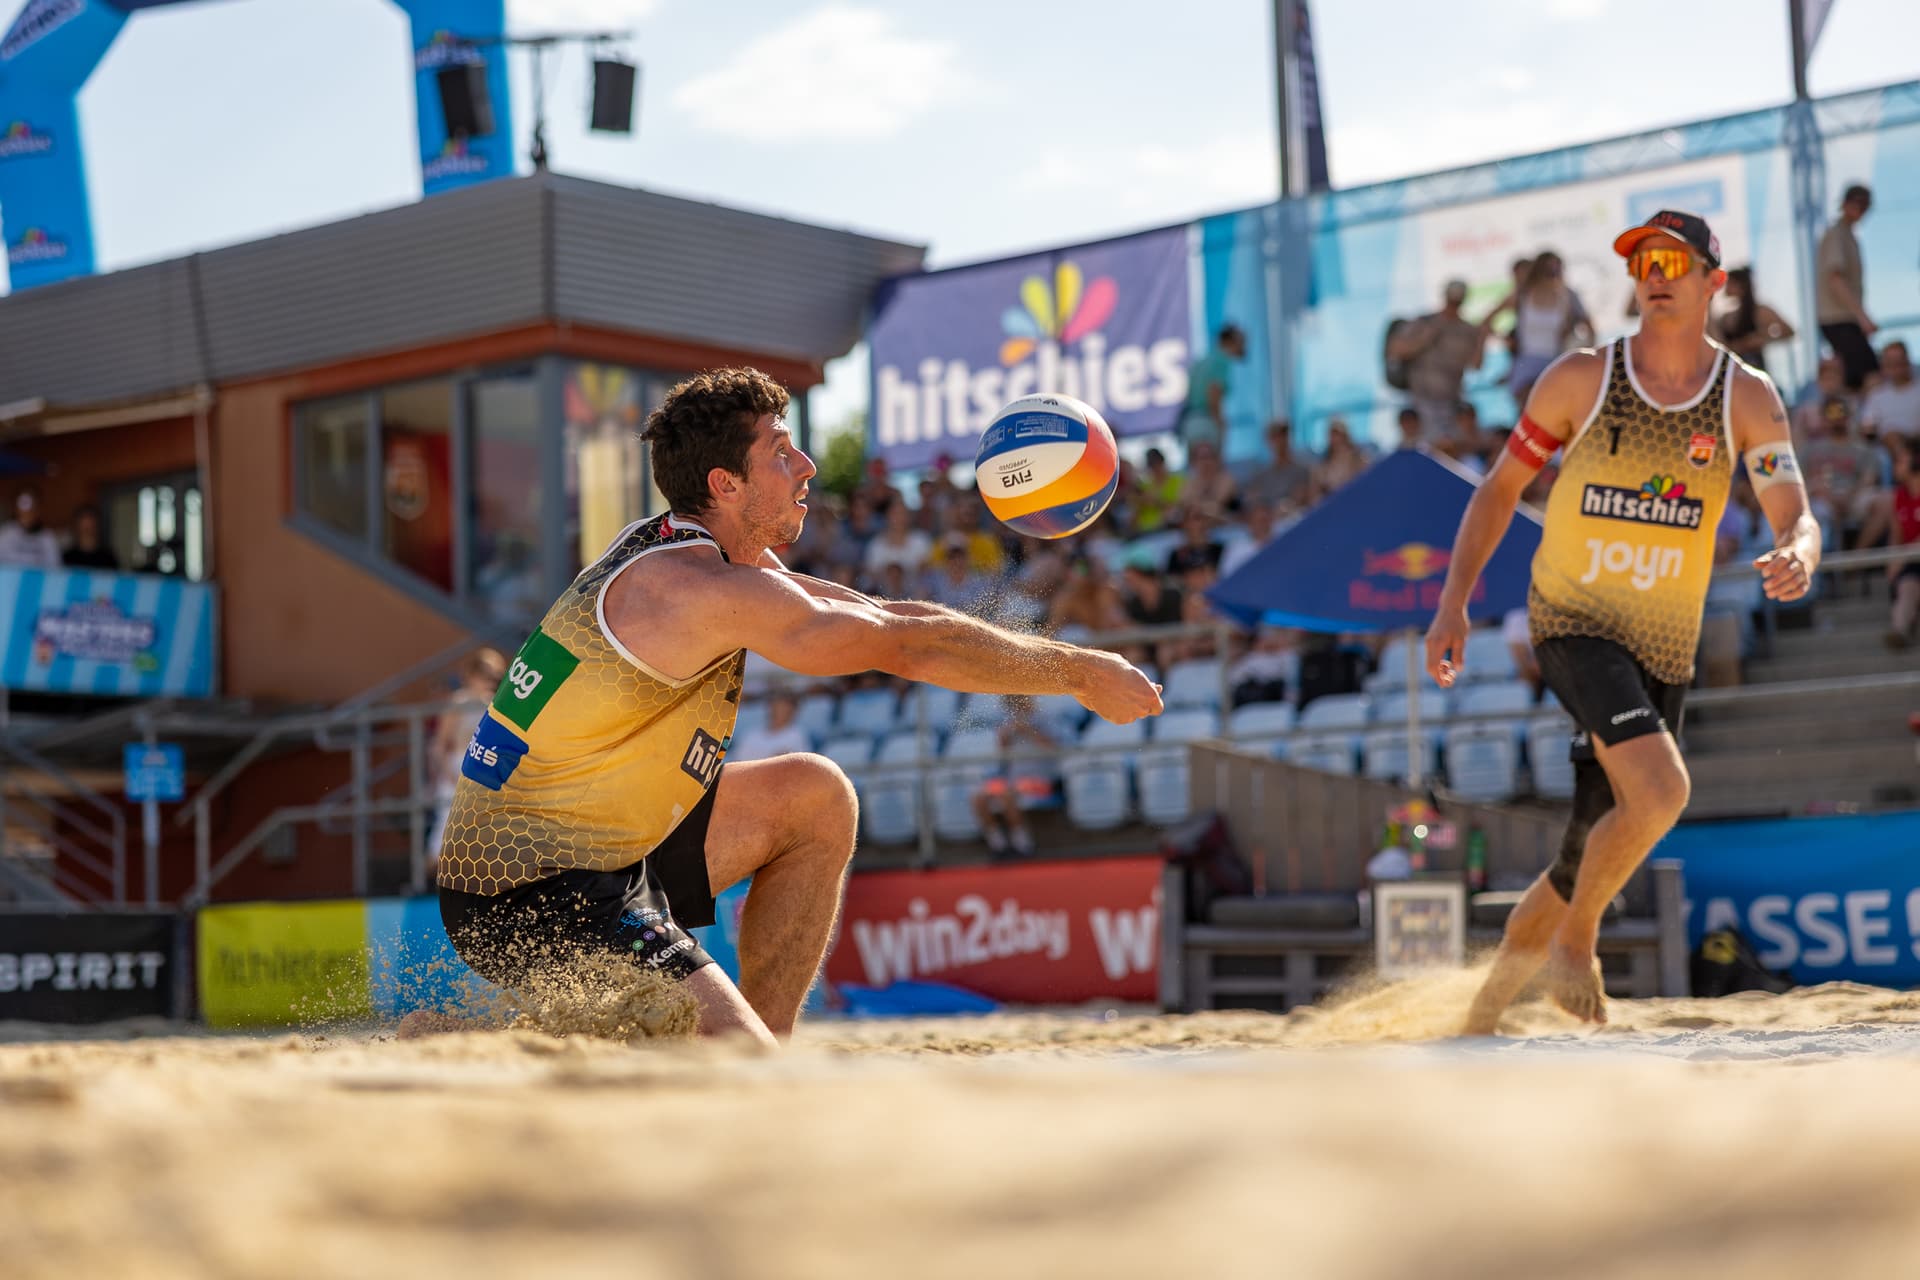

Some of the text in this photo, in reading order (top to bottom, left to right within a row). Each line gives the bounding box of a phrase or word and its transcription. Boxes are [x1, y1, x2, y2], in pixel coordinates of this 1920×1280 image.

[876, 332, 1189, 446] hitschies
[1002, 469, 1033, 488] FIVB
[1583, 486, 1701, 528] hitschies
